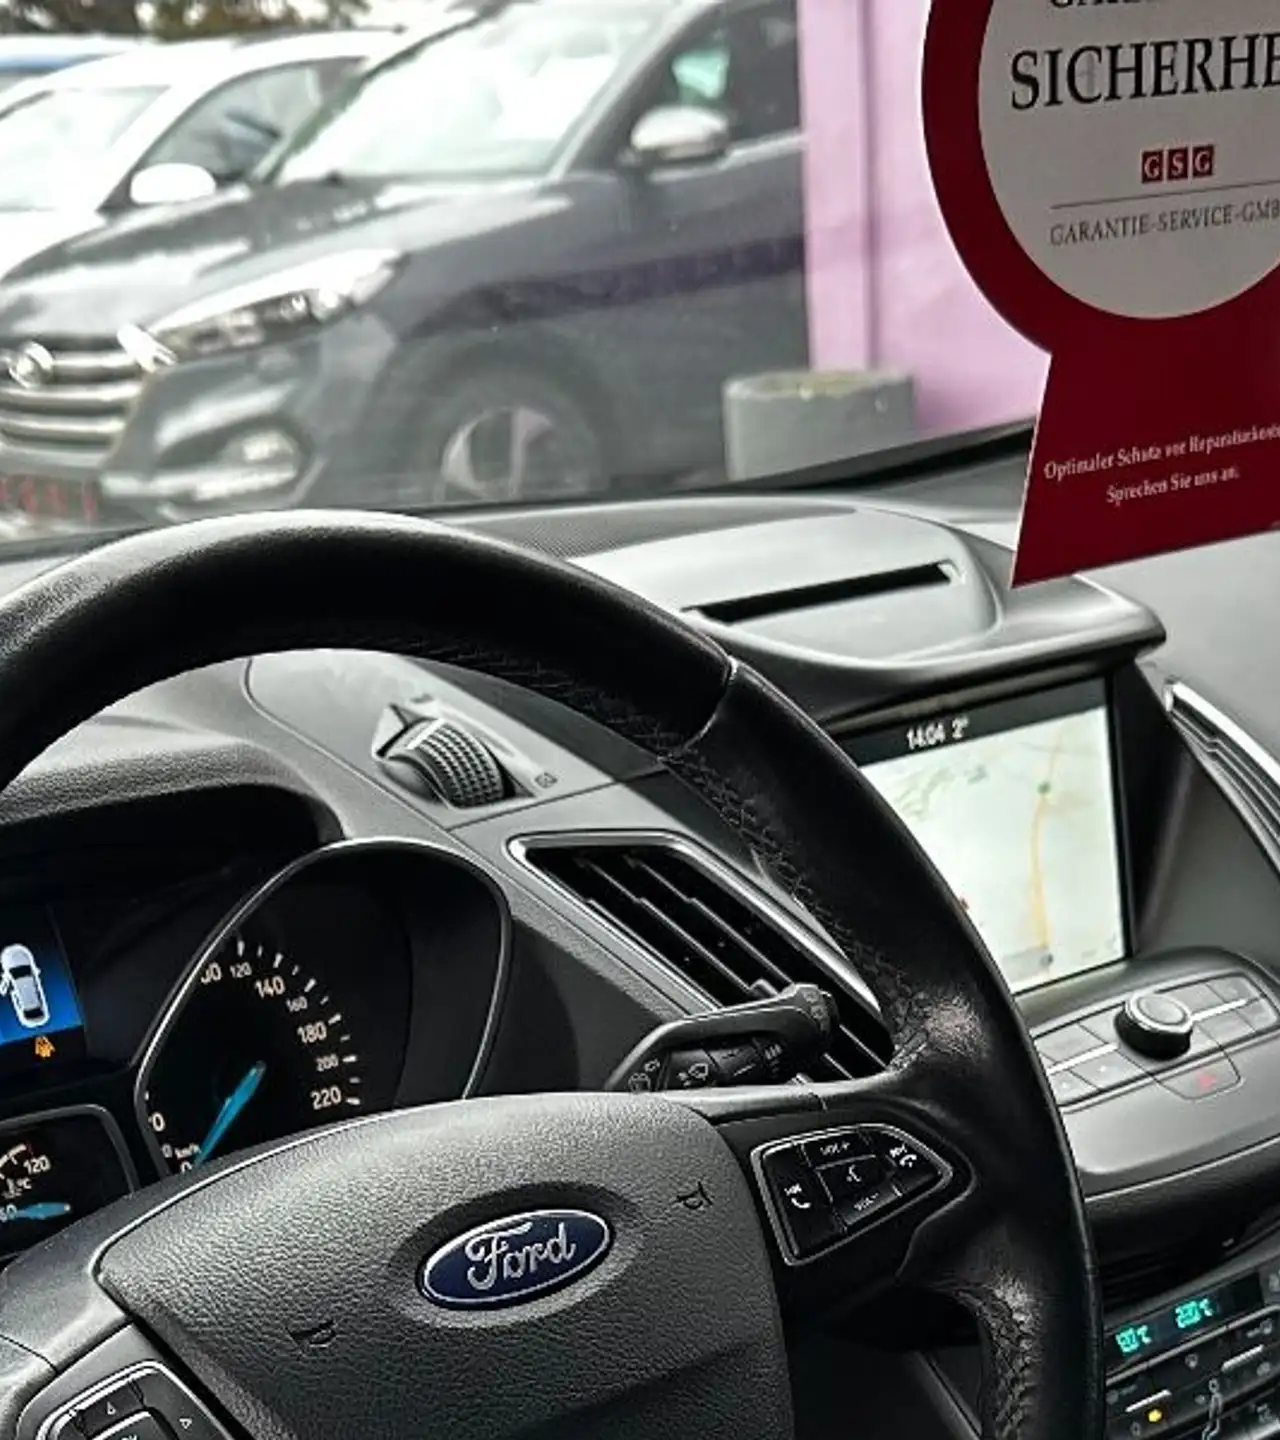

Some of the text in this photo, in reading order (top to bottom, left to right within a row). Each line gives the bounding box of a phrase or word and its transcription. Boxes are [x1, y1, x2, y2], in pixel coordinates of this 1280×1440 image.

[1142, 146, 1214, 183] GSG
[1043, 452, 1115, 482] Optimaler
[1106, 479, 1169, 507] Sprechen
[255, 975, 286, 998] 140
[297, 1021, 328, 1044] 180
[310, 1085, 342, 1110] 220
[23, 1154, 51, 1175] 120
[464, 1221, 577, 1291] Ford
